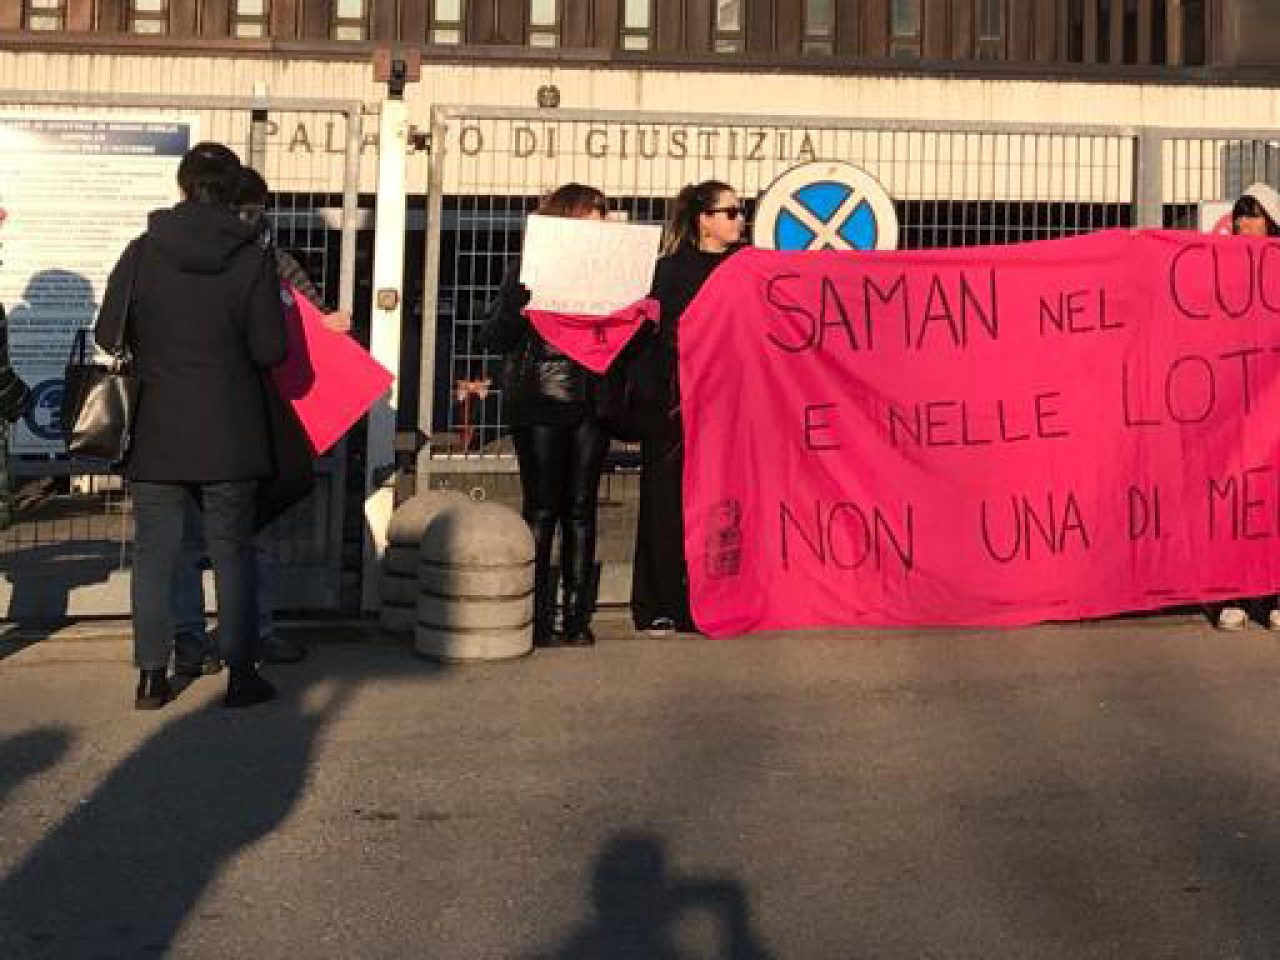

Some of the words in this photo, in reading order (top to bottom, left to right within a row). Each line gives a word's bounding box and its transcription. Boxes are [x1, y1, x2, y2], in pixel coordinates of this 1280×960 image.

[514, 127, 556, 158] DI
[584, 127, 816, 162] GIUSTIZIA
[767, 267, 999, 354] SAMAN
[1039, 288, 1124, 335] NEL
[804, 403, 841, 451] E
[889, 392, 1071, 448] NELLE
[779, 499, 914, 573] NON
[980, 490, 1091, 563] UNA
[1127, 484, 1161, 541] DI
